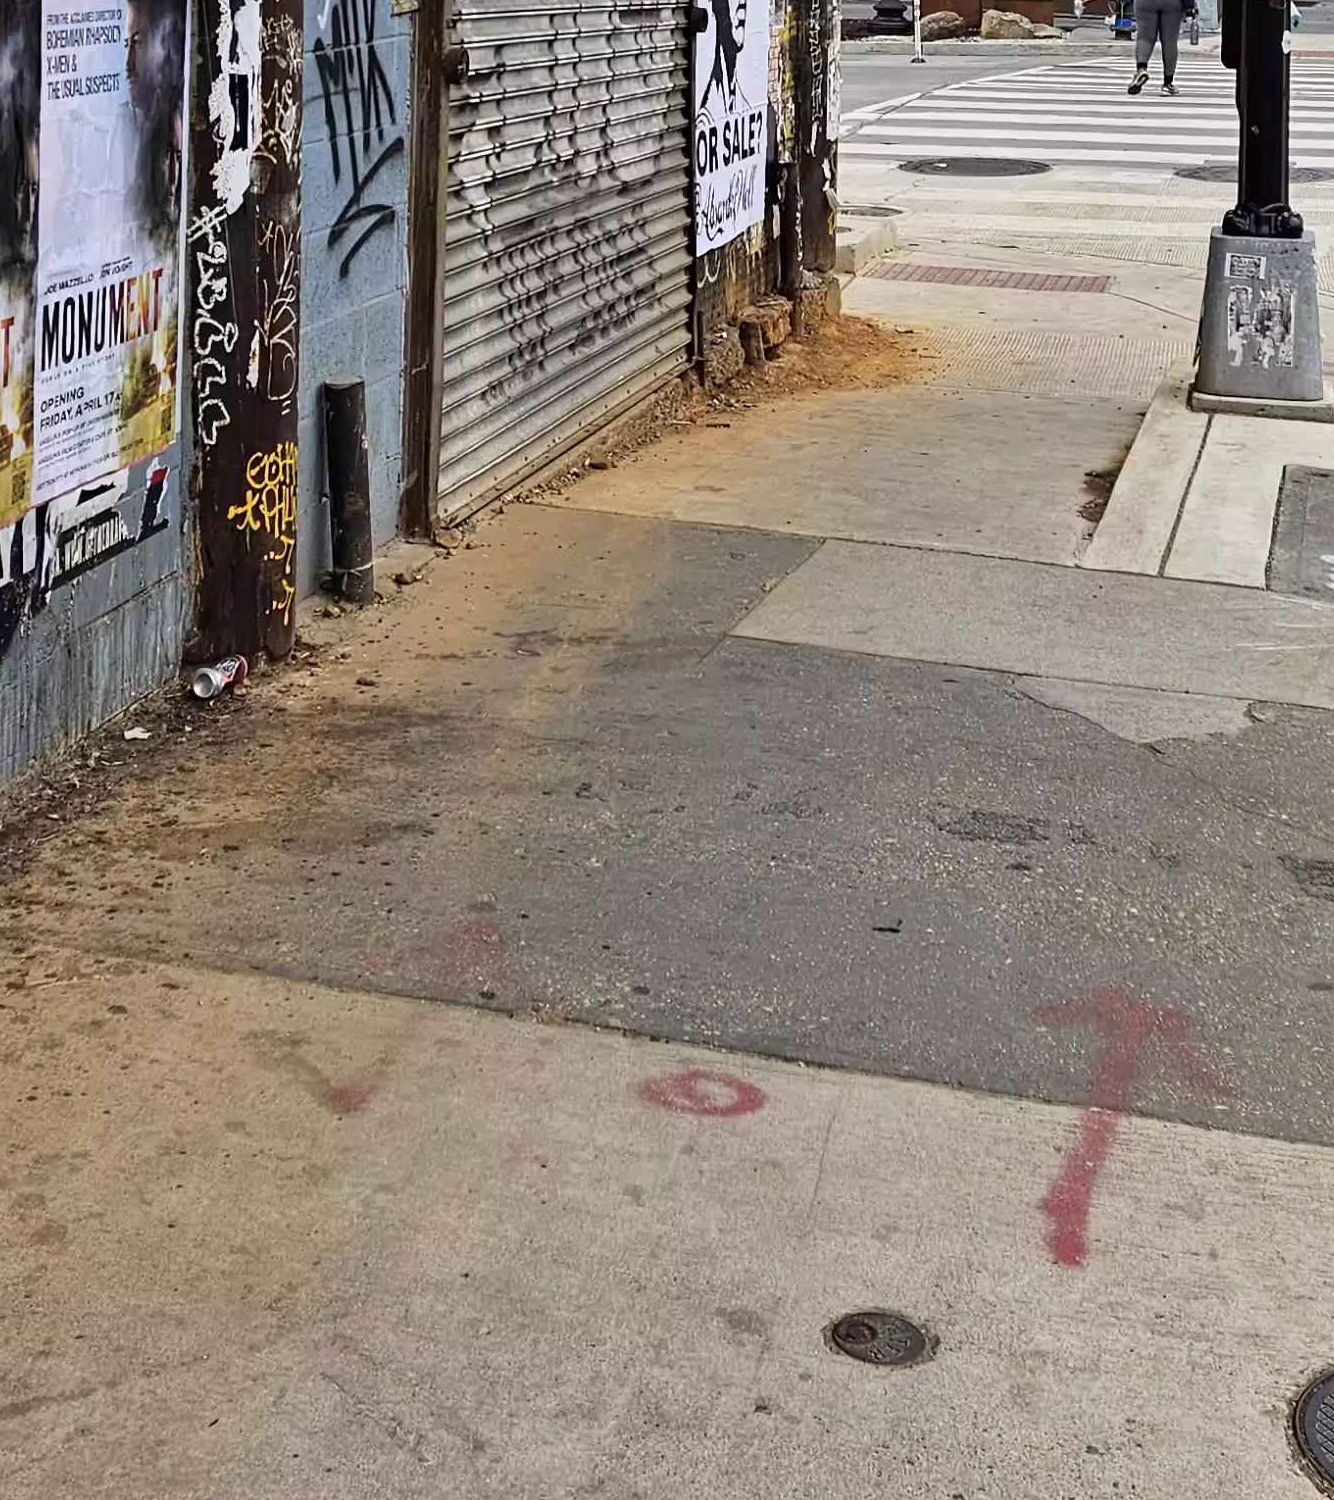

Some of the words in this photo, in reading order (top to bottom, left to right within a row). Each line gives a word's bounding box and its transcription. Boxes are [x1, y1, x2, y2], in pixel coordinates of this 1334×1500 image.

[723, 110, 763, 167] SALE?
[41, 267, 163, 372] MONUMENT
[40, 386, 84, 413] OPENING
